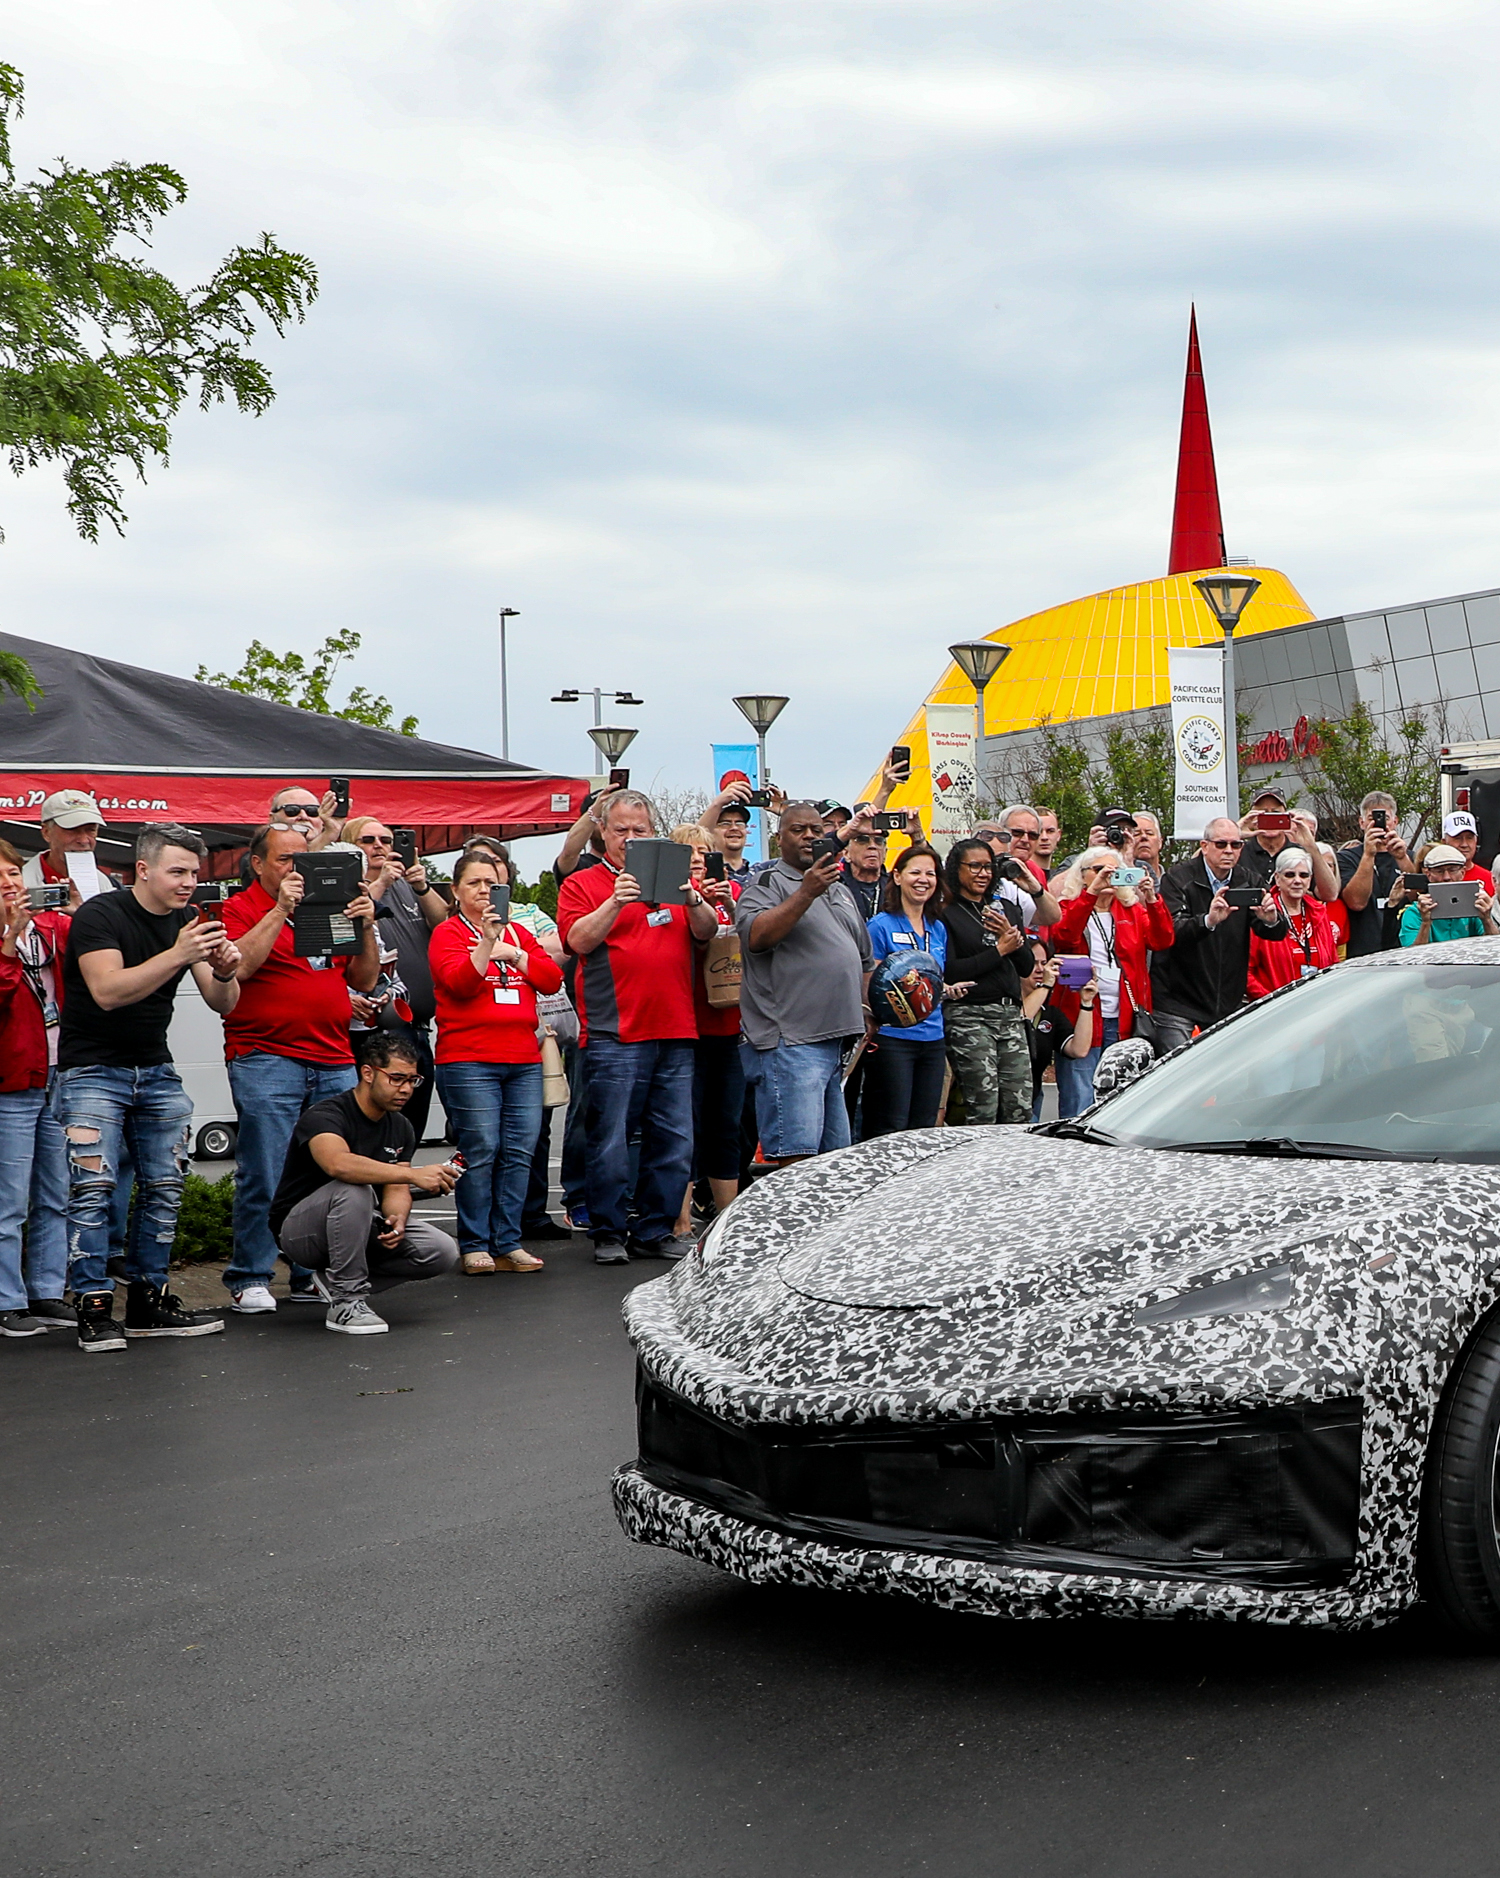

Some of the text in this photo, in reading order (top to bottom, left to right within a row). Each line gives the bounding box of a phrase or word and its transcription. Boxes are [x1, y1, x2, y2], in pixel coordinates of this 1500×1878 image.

[1173, 685, 1221, 694] PACIFIC COAST
[1172, 696, 1223, 704] CORVETTE CLUB
[1181, 718, 1222, 742] PACIFIC COAST
[1182, 749, 1222, 770] CORVETTE CLUB
[950, 758, 976, 780] ODYSSEY
[1184, 784, 1219, 793] SOUTHERN
[932, 792, 961, 814] CORVETTE
[1176, 794, 1204, 802] OREGON
[1452, 816, 1472, 827] USA
